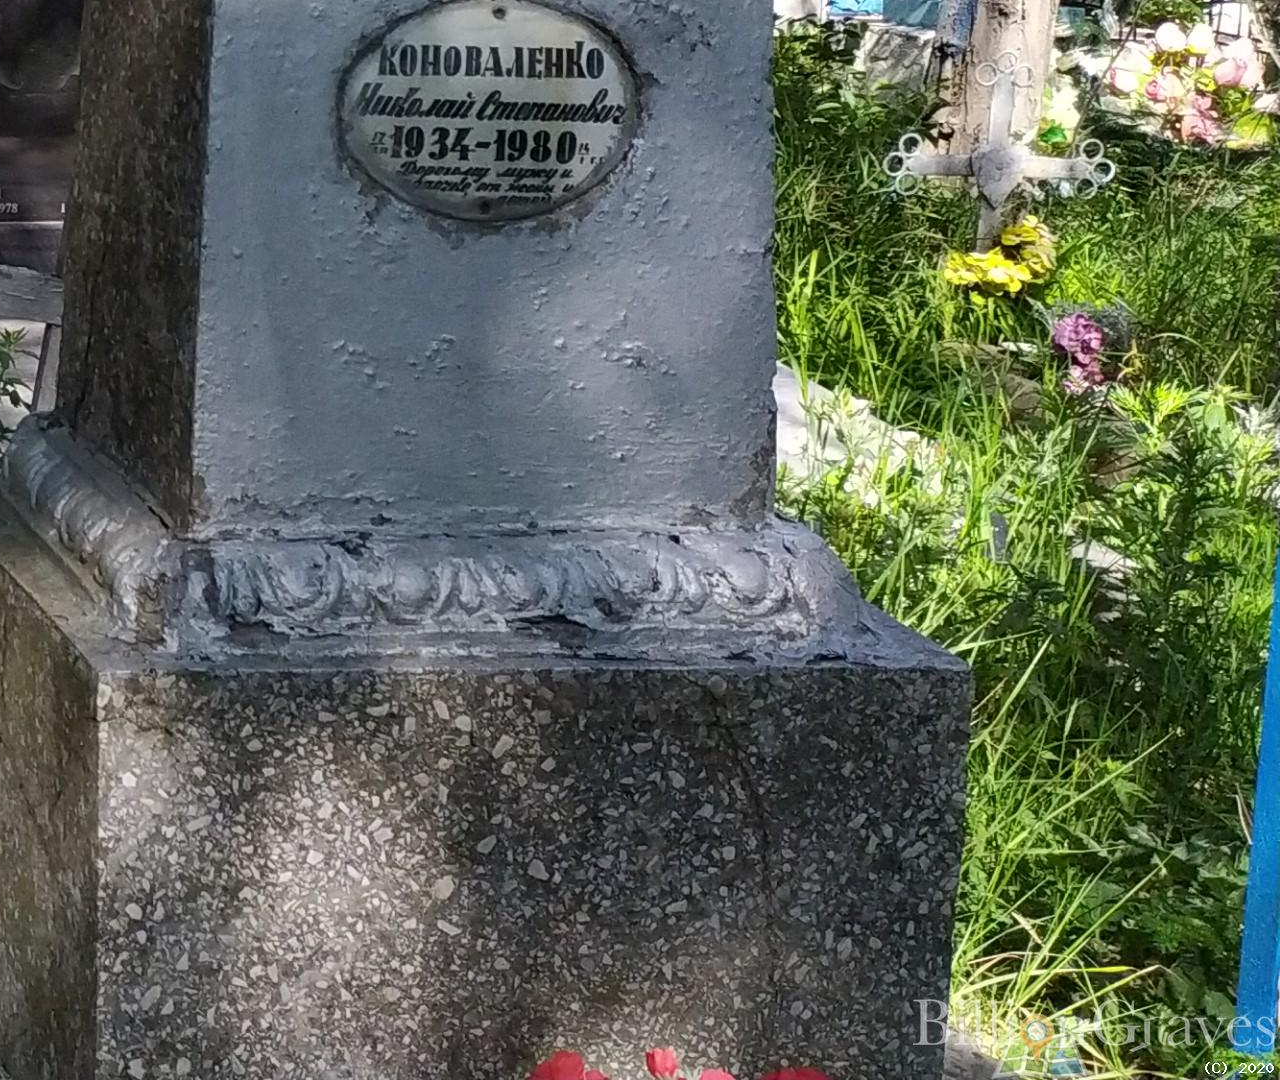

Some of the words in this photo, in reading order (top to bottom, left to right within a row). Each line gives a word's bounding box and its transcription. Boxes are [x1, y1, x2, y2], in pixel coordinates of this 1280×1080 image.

[377, 40, 605, 80] КОНОВАЛЕНКО
[357, 82, 476, 119] Николай
[476, 87, 627, 124] Степанович
